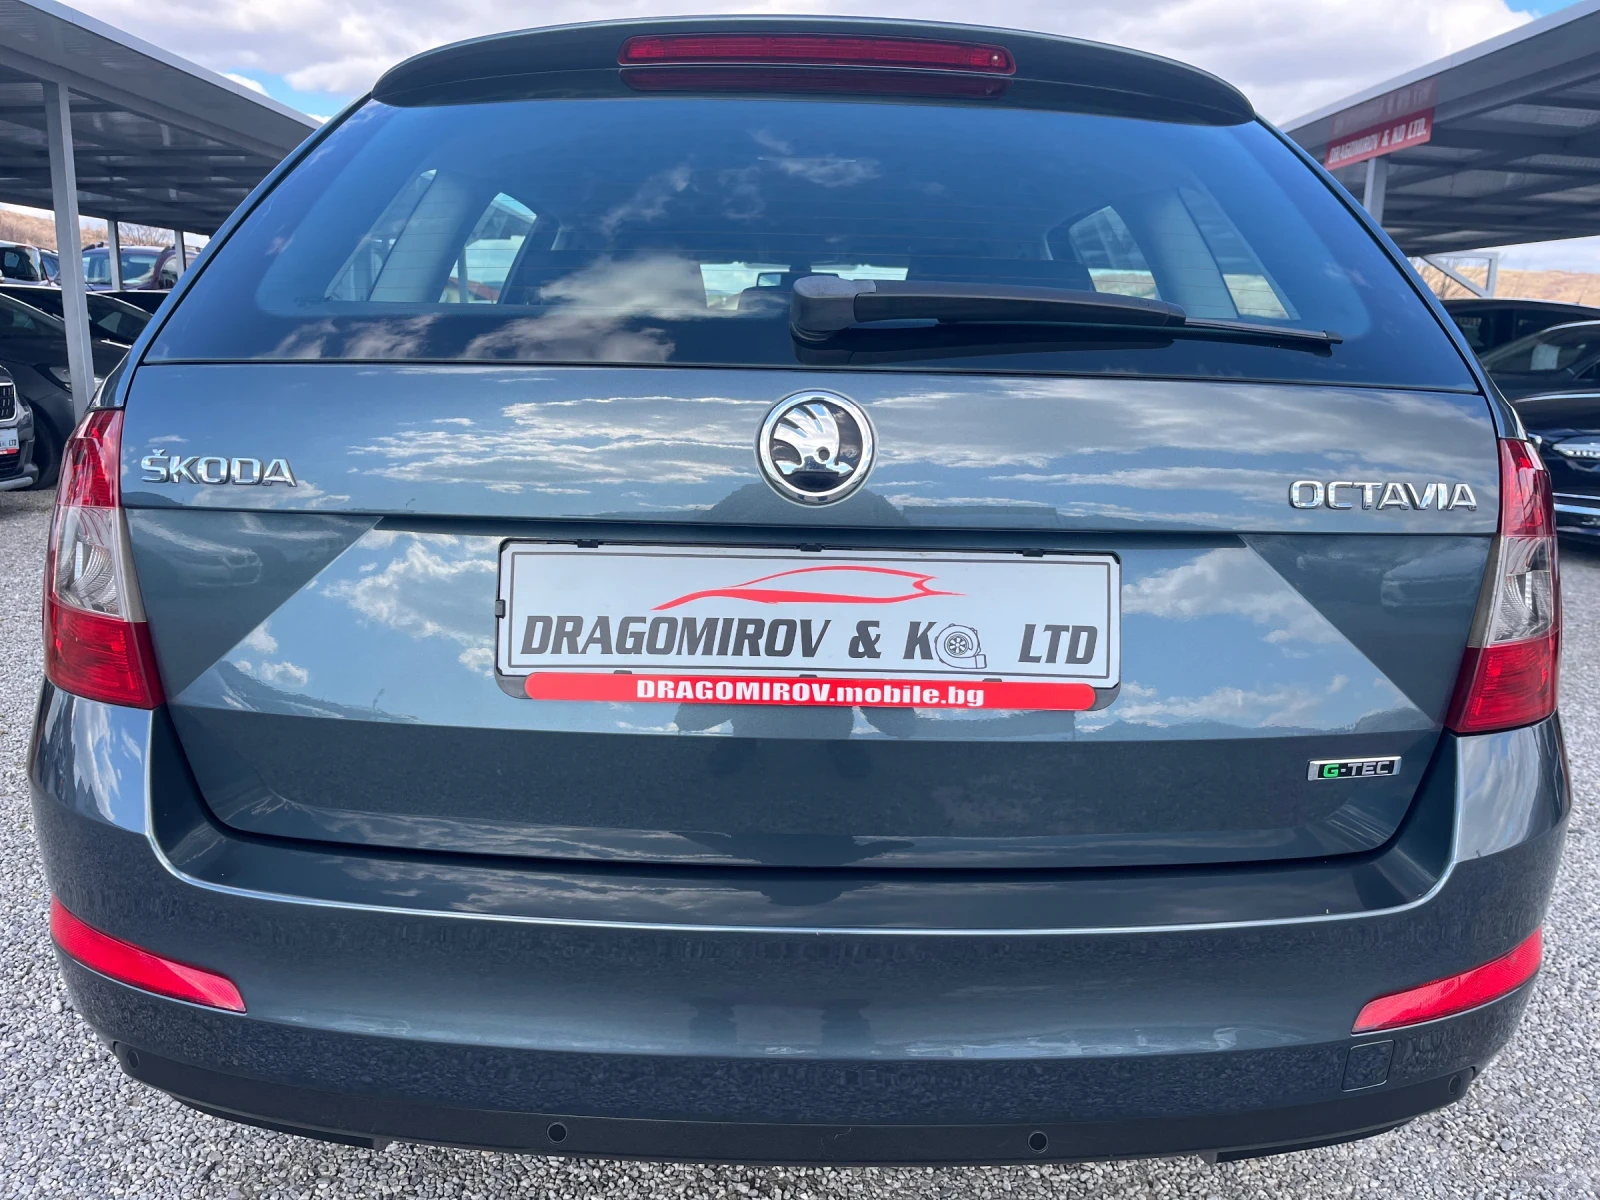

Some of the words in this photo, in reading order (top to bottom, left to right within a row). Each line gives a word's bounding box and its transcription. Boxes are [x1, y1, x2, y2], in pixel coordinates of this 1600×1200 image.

[141, 449, 298, 487] ŠKODA
[1289, 480, 1479, 511] OCTAVIA
[520, 615, 832, 658] DRAGOMIROV
[848, 620, 882, 659] &
[1017, 623, 1098, 665] LTD
[636, 679, 985, 707] DRAGOMIROV.mobile.bg
[1323, 761, 1390, 778] G-TEC
